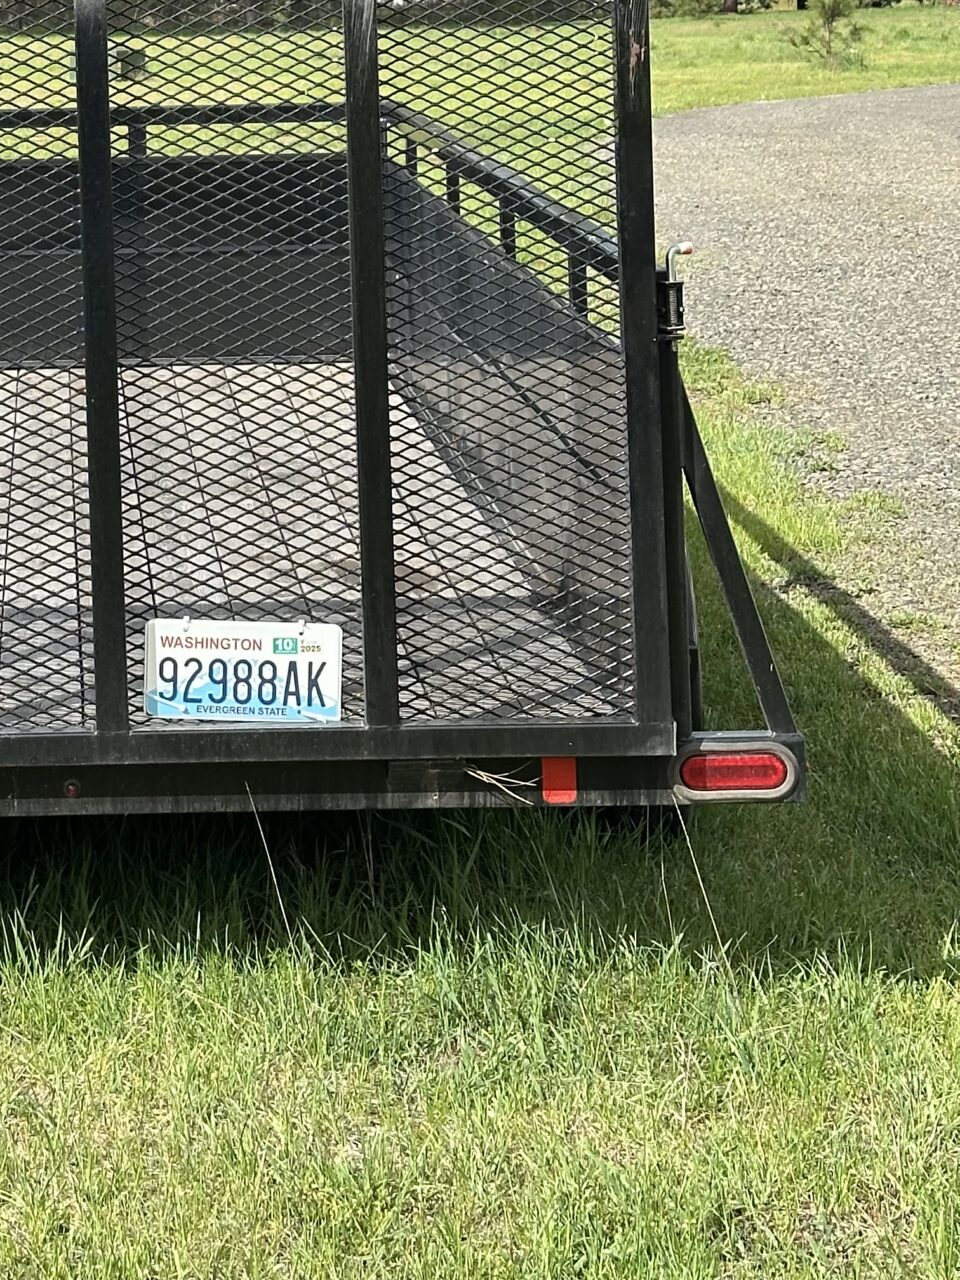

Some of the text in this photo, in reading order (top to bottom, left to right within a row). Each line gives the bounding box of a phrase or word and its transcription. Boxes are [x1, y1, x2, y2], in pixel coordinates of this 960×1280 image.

[160, 635, 263, 651] WASHINGTON
[276, 639, 293, 651] 10
[300, 645, 321, 653] 2025
[158, 656, 327, 708] 92988AK
[196, 705, 288, 716] EVERGREEN STATE
